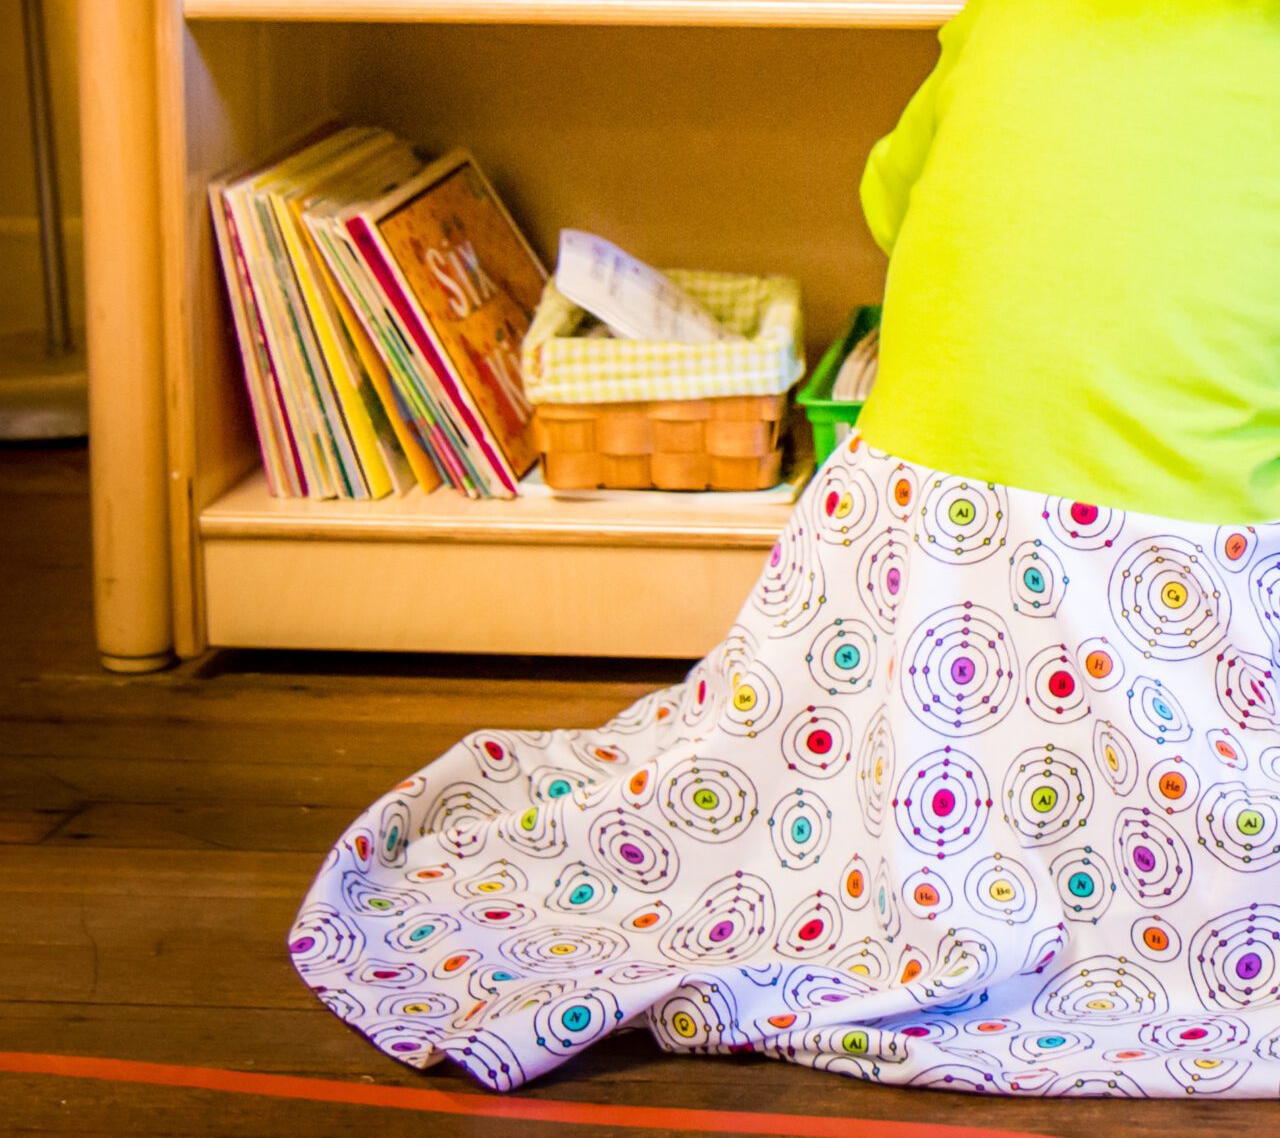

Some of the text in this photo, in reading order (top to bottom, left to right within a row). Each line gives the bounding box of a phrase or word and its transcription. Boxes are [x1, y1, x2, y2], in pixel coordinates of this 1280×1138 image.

[955, 507, 969, 518] Al
[1031, 574, 1040, 587] N
[1167, 588, 1180, 602] Ca
[1094, 658, 1105, 671] H
[957, 665, 967, 678] K
[738, 692, 752, 704] Be
[1165, 779, 1182, 792] He
[1037, 794, 1052, 806] Al
[1243, 817, 1258, 829] Al
[796, 824, 806, 836] N
[1137, 852, 1151, 866] Na
[1075, 879, 1087, 891] N
[919, 891, 934, 902] He
[1244, 961, 1253, 973] K
[569, 1011, 583, 1024] N
[848, 1037, 863, 1050] Al
